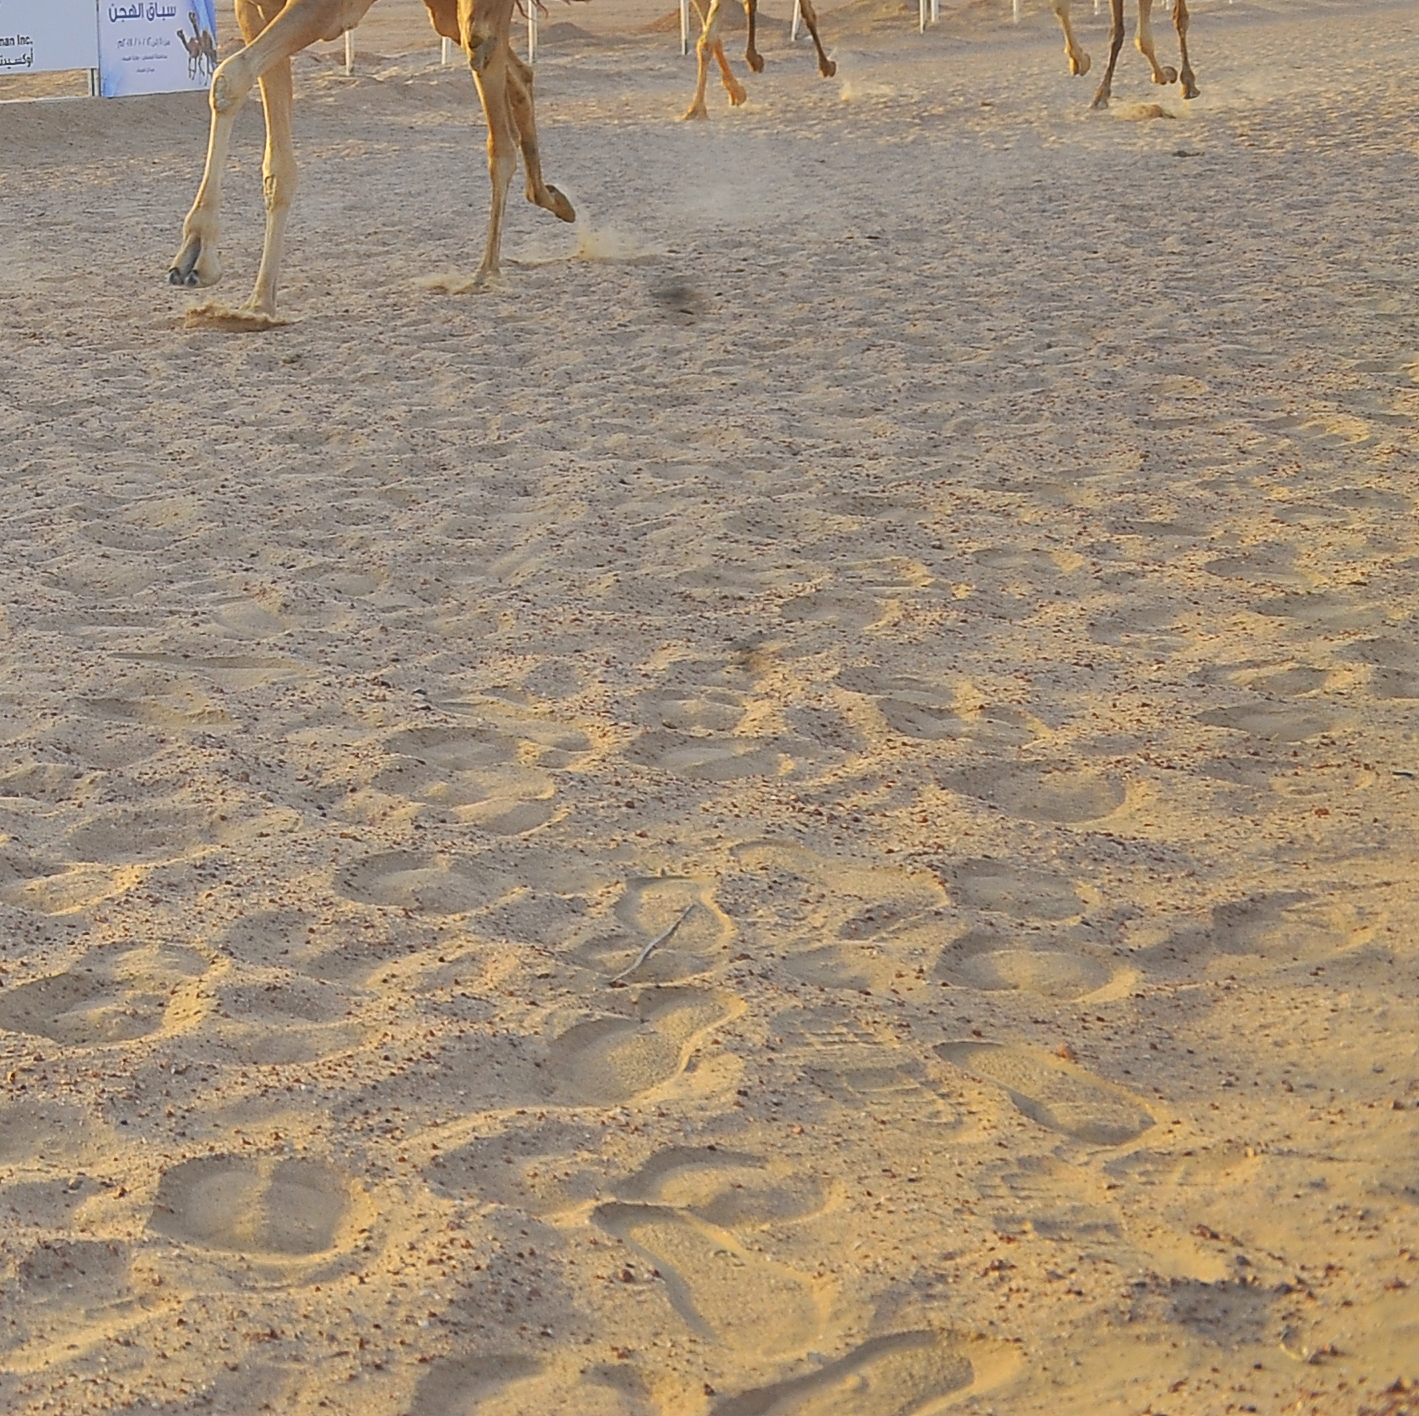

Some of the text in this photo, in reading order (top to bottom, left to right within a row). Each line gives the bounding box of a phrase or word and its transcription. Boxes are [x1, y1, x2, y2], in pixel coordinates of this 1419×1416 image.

[109, 2, 176, 22] سباق الهجن
[17, 34, 33, 45] Inc.
